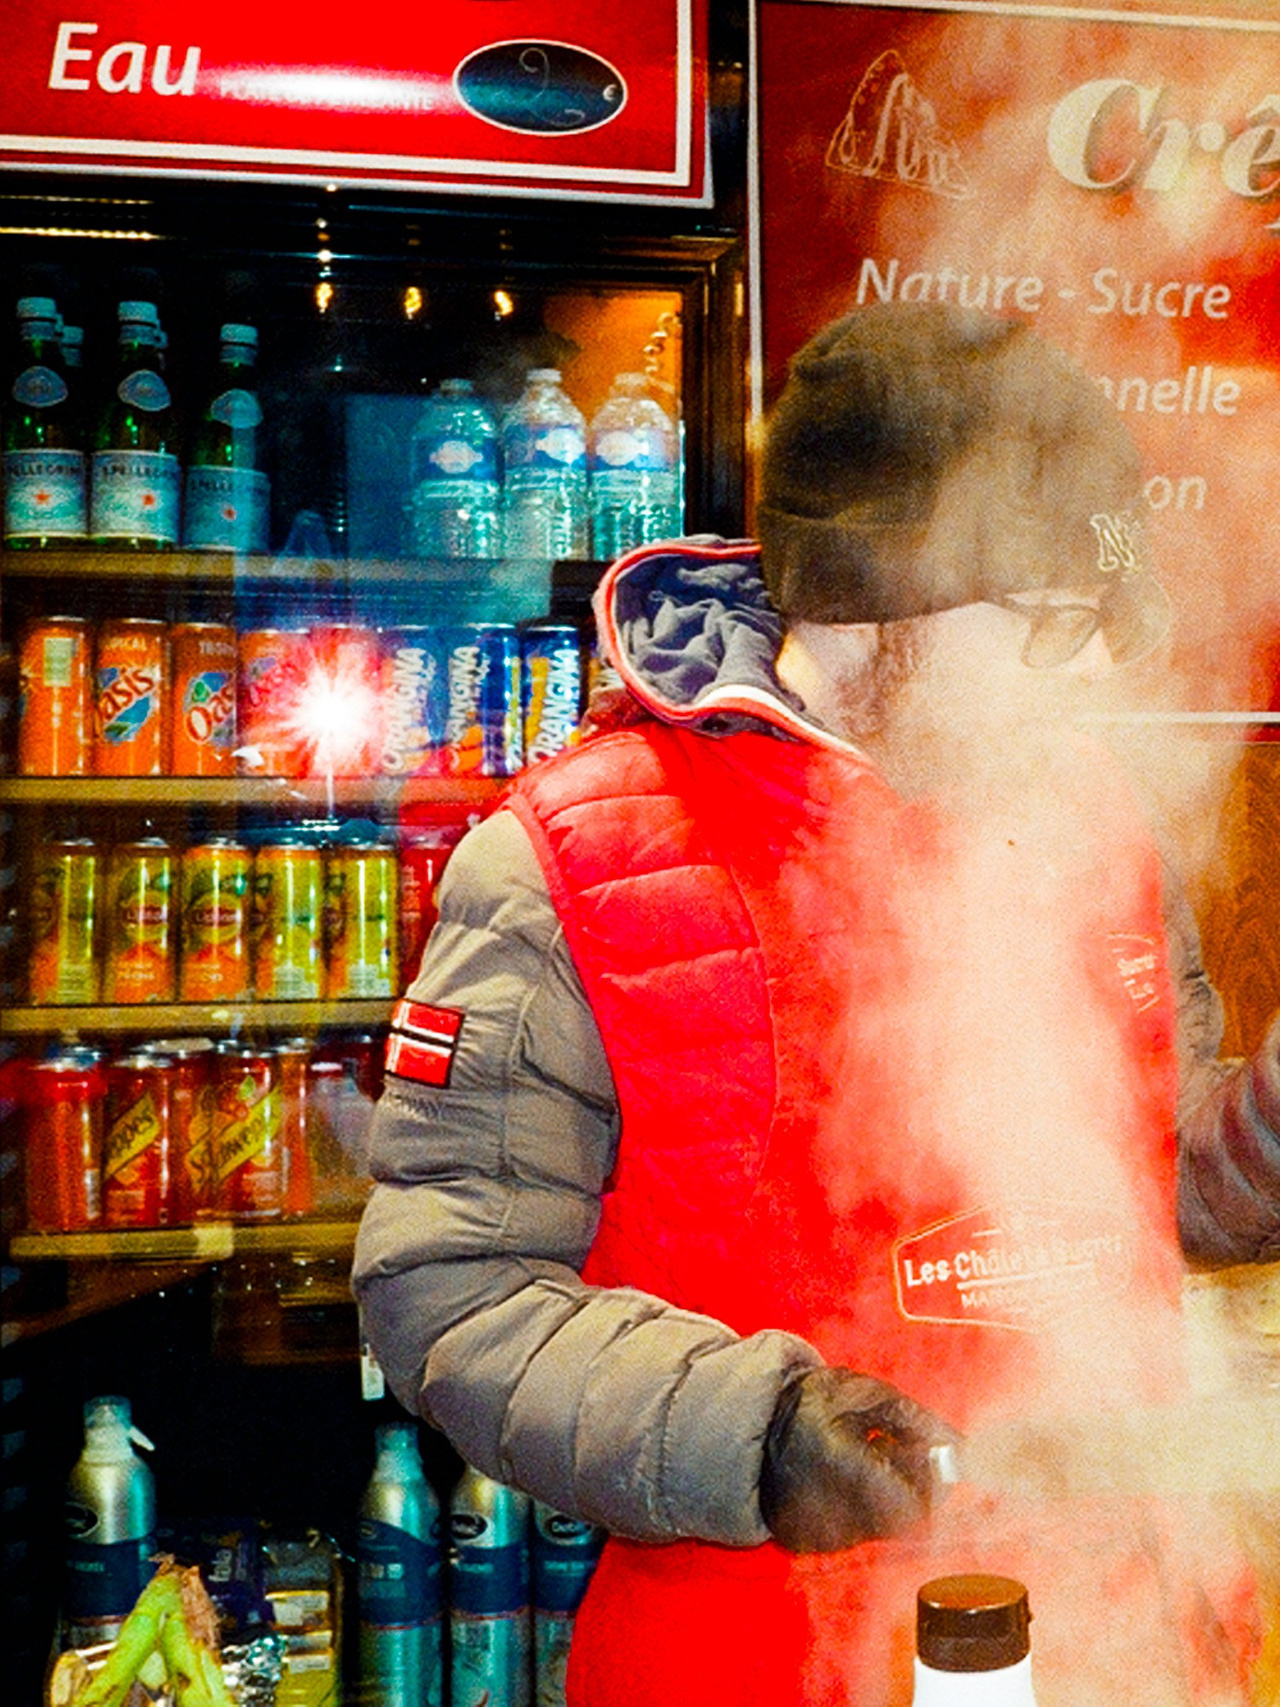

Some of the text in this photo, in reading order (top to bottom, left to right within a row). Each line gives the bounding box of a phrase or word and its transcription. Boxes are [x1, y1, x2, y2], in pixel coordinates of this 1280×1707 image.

[47, 21, 202, 97] Eau
[856, 257, 1044, 313] Nature
[1089, 268, 1231, 320] Sucre
[97, 663, 155, 733] asis
[904, 1259, 951, 1287] Les
